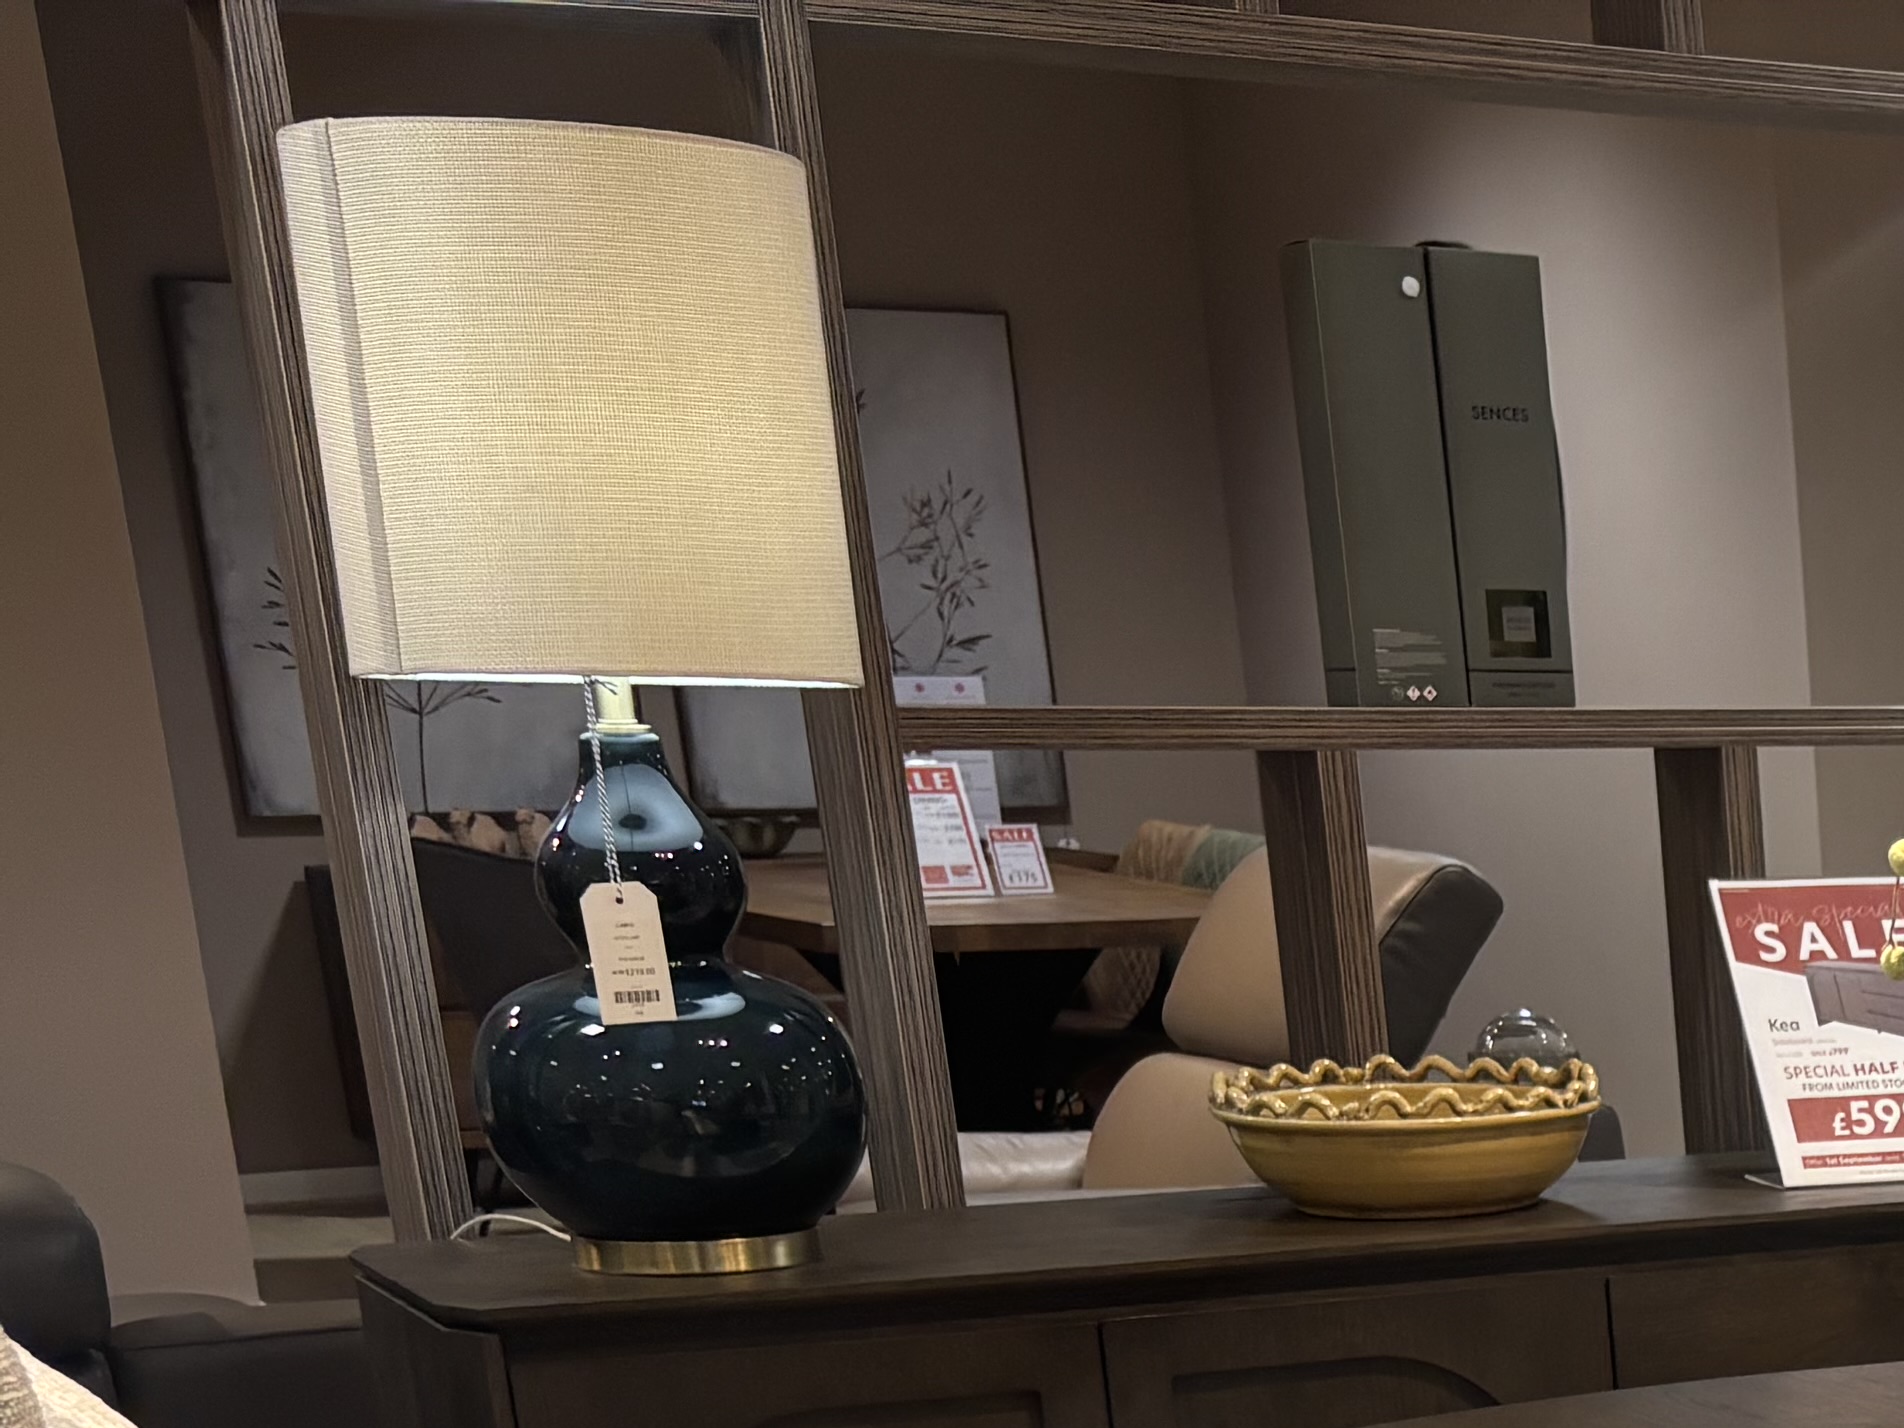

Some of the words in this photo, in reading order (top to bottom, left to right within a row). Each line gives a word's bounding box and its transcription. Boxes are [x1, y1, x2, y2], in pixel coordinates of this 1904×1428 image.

[1768, 1018, 1800, 1033] Kea
[1784, 1063, 1850, 1080] SPECIAL
[1853, 1061, 1899, 1077] HALF
[1802, 1082, 1834, 1092] FROM
[1837, 1080, 1880, 1091] LIMITED
